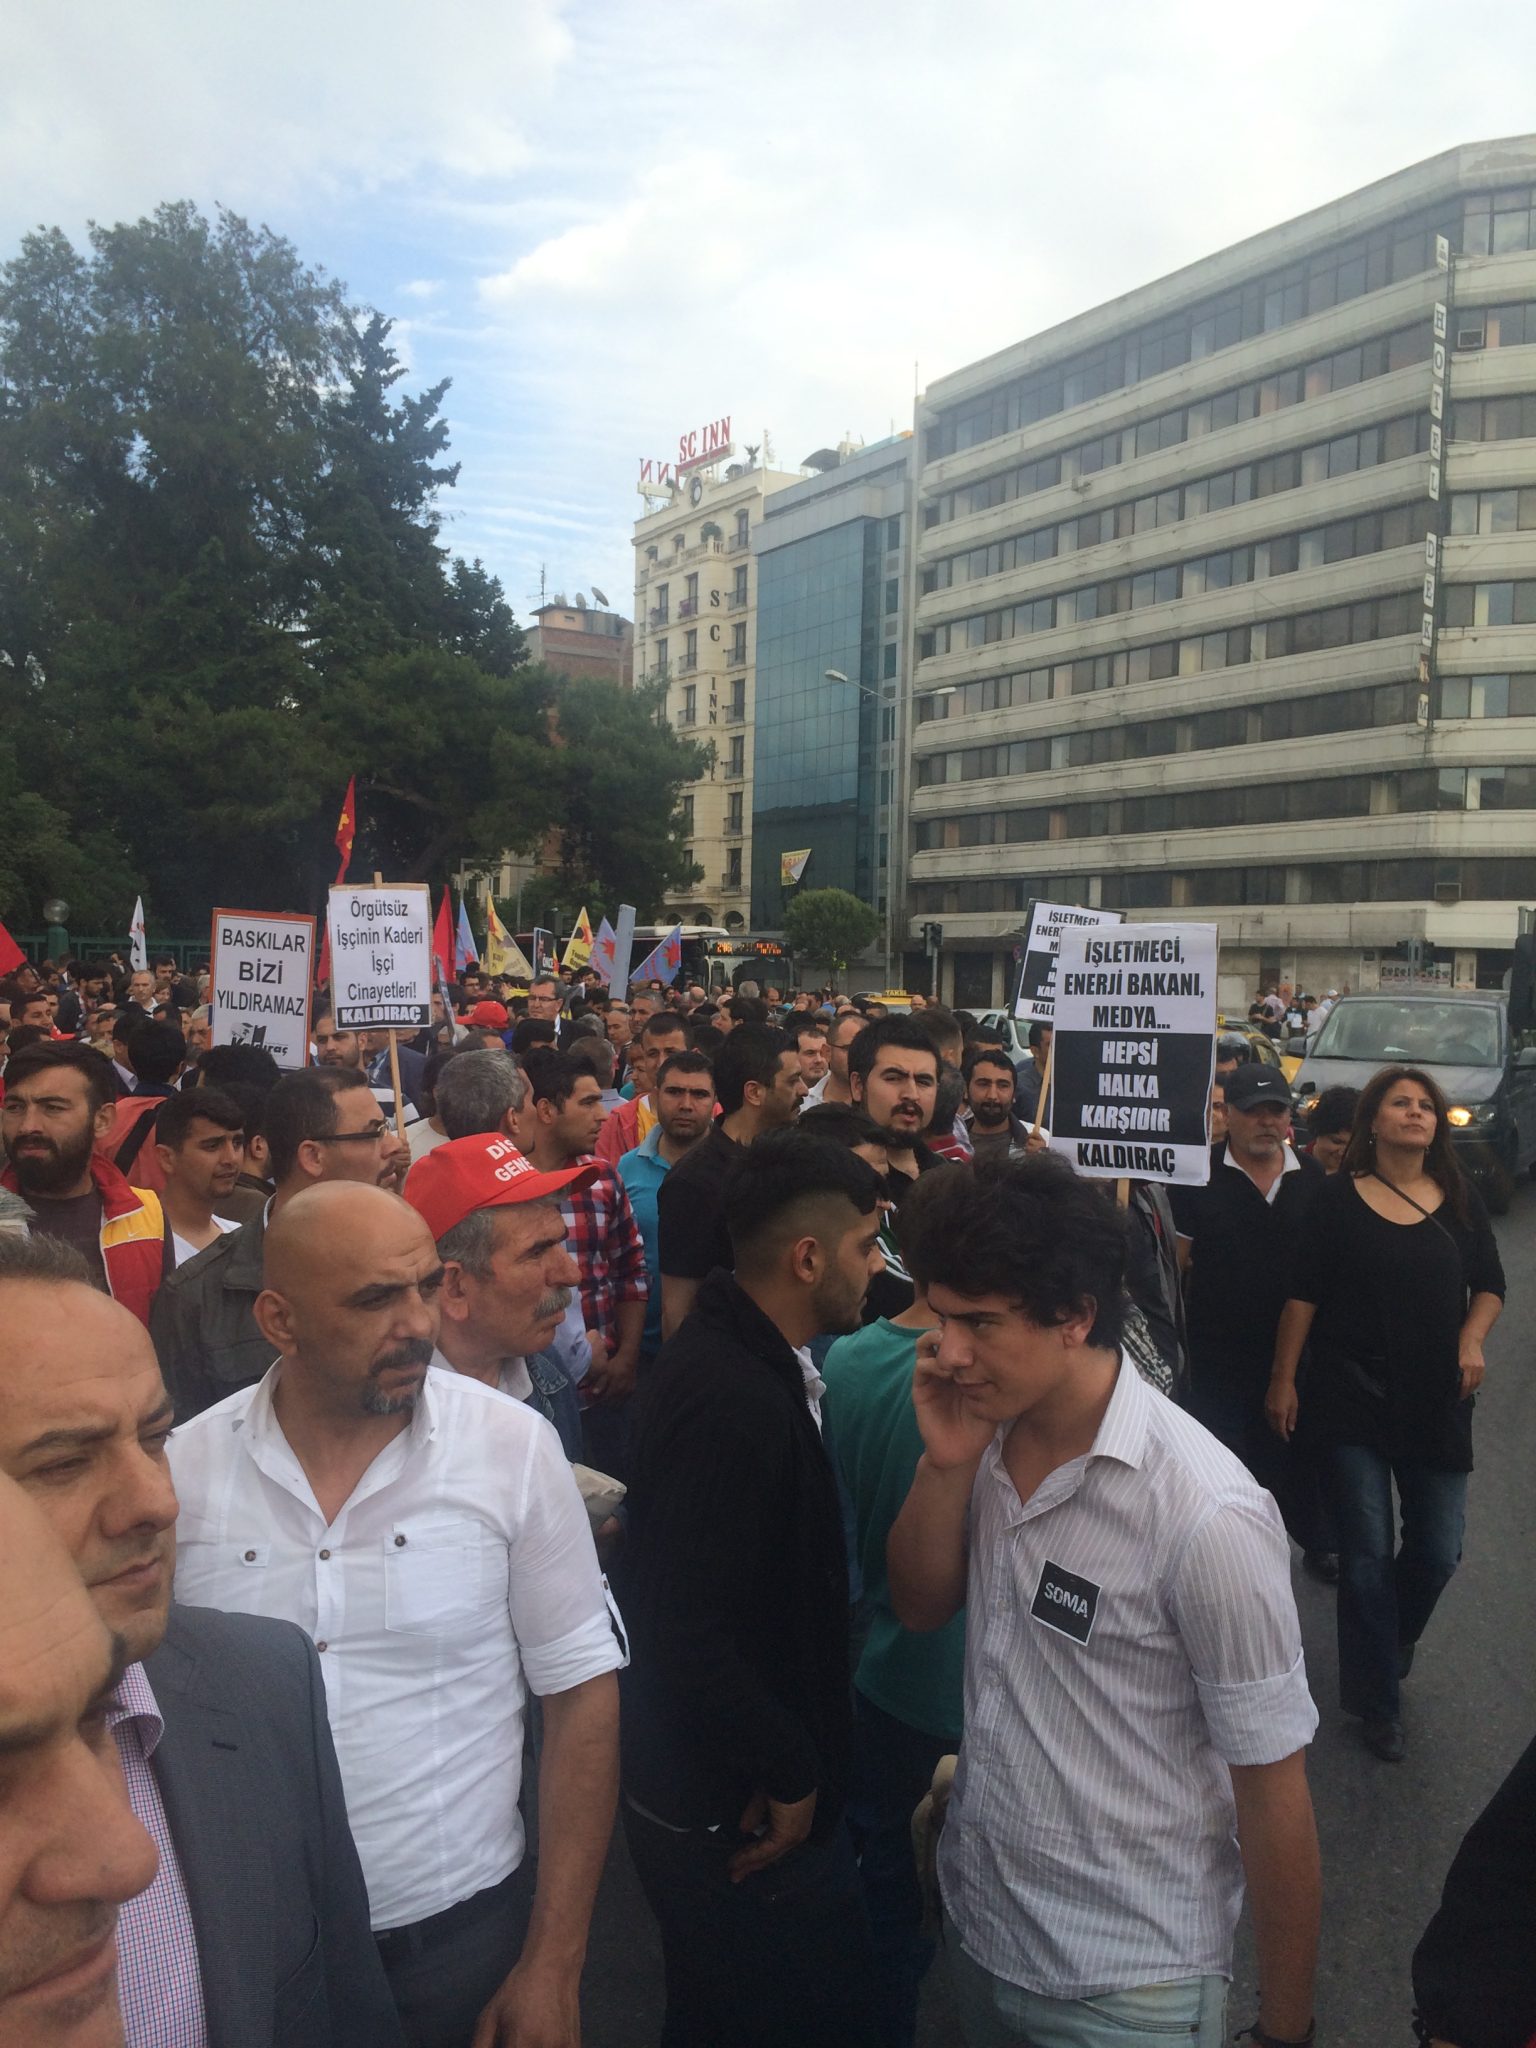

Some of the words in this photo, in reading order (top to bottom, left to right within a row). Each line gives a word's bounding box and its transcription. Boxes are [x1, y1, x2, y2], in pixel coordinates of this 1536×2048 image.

[1431, 308, 1445, 494] HOTEL
[680, 430, 697, 463] SC
[702, 416, 731, 453] INN
[710, 589, 720, 642] SC
[708, 676, 718, 725] INN
[350, 896, 409, 921] Örgütsüz
[222, 928, 306, 953] BASKILAR
[337, 924, 380, 950] İşçinin
[384, 926, 423, 945] Kaderi
[371, 951, 394, 976] İşçi
[1084, 936, 1185, 968] İŞLETMECİ,
[238, 958, 283, 985] BİZİ
[1064, 970, 1123, 996] ENERJİ
[1127, 972, 1205, 999] BAKANI,
[216, 989, 305, 1017] YILDIRAMAZ
[348, 982, 417, 1004] Cinayetleri!
[341, 1005, 422, 1024] KALDIRAÇ
[1092, 1005, 1171, 1030] MEDYA...
[1102, 1038, 1159, 1066] HEPSİ
[1098, 1073, 1160, 1099] HALKA
[1081, 1104, 1171, 1135] KARŞIDIR
[1077, 1142, 1175, 1178] KALDIRAÇ
[1044, 1582, 1088, 1618] SOMA
